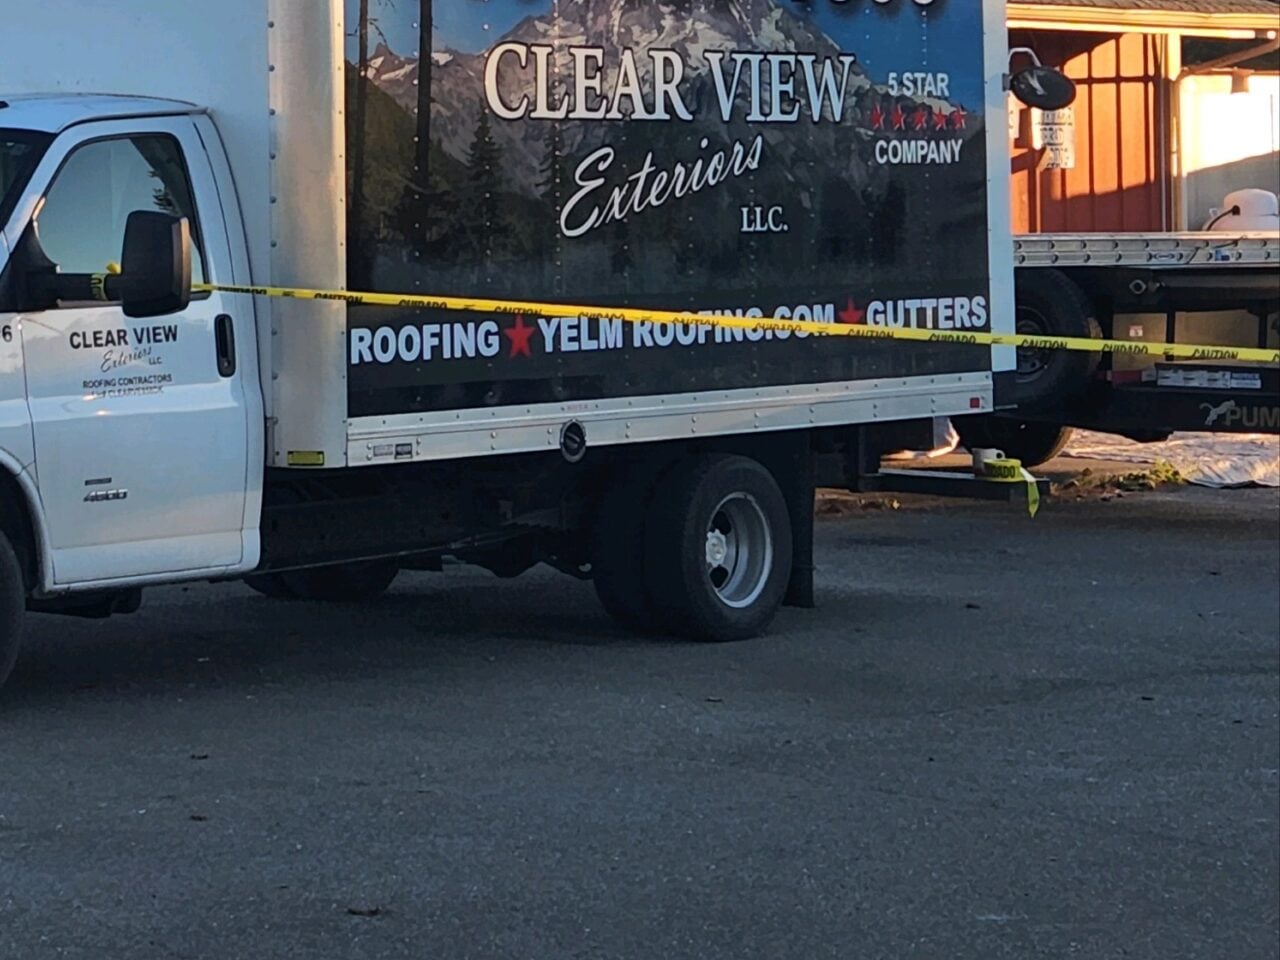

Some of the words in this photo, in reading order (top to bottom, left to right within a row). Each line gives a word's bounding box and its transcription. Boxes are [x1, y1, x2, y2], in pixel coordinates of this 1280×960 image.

[484, 42, 693, 121] CLEAR
[704, 52, 855, 122] VIEW
[888, 72, 898, 96] 5
[902, 72, 950, 97] STAR
[875, 139, 963, 164] COMPANY
[559, 135, 763, 237] Exteriors
[740, 206, 789, 232] LLC.
[69, 329, 129, 350] CLEAR
[133, 324, 178, 345] VIEW
[350, 321, 500, 365] ROOFING
[537, 316, 624, 353] YELM
[866, 295, 987, 329] GUTTERS
[1021, 339, 1068, 350] CAUTION
[1102, 343, 1149, 355] CUIDADO
[1191, 348, 1239, 360] CAUTION
[82, 378, 117, 389] ROOFING
[118, 373, 172, 386] CONTRACTORS
